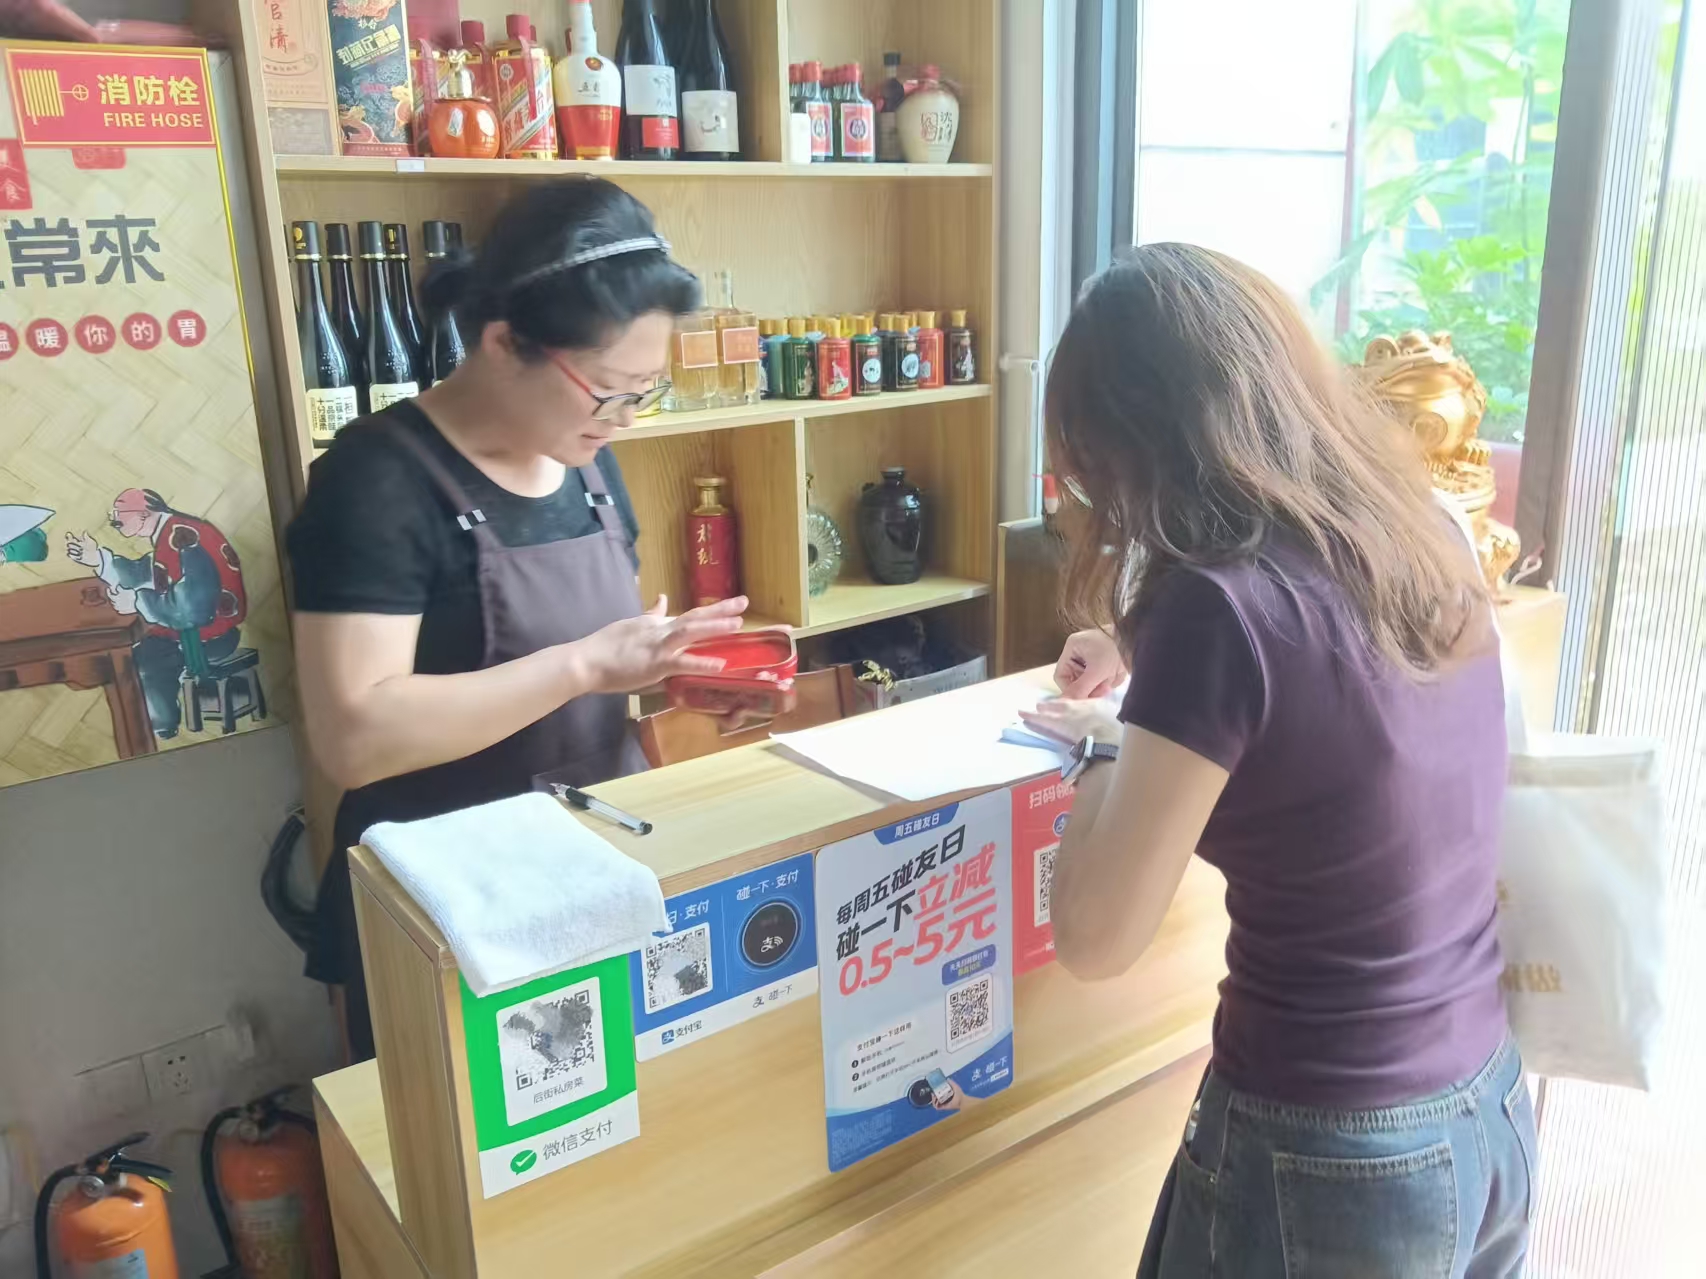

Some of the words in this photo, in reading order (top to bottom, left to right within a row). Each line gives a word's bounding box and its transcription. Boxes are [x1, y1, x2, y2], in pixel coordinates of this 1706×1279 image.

[97, 74, 200, 106] 消防栓
[104, 112, 146, 127] FIRE
[151, 112, 203, 127] HOSE
[0, 214, 165, 289] 常來
[894, 813, 940, 839] 周五碰友日
[836, 824, 966, 925] 每周五碰友日
[839, 888, 997, 996] 0.5~5元
[675, 1020, 702, 1038] 支付宝
[533, 1076, 584, 1104] 后街私房菜
[542, 1119, 613, 1160] 微信支付
